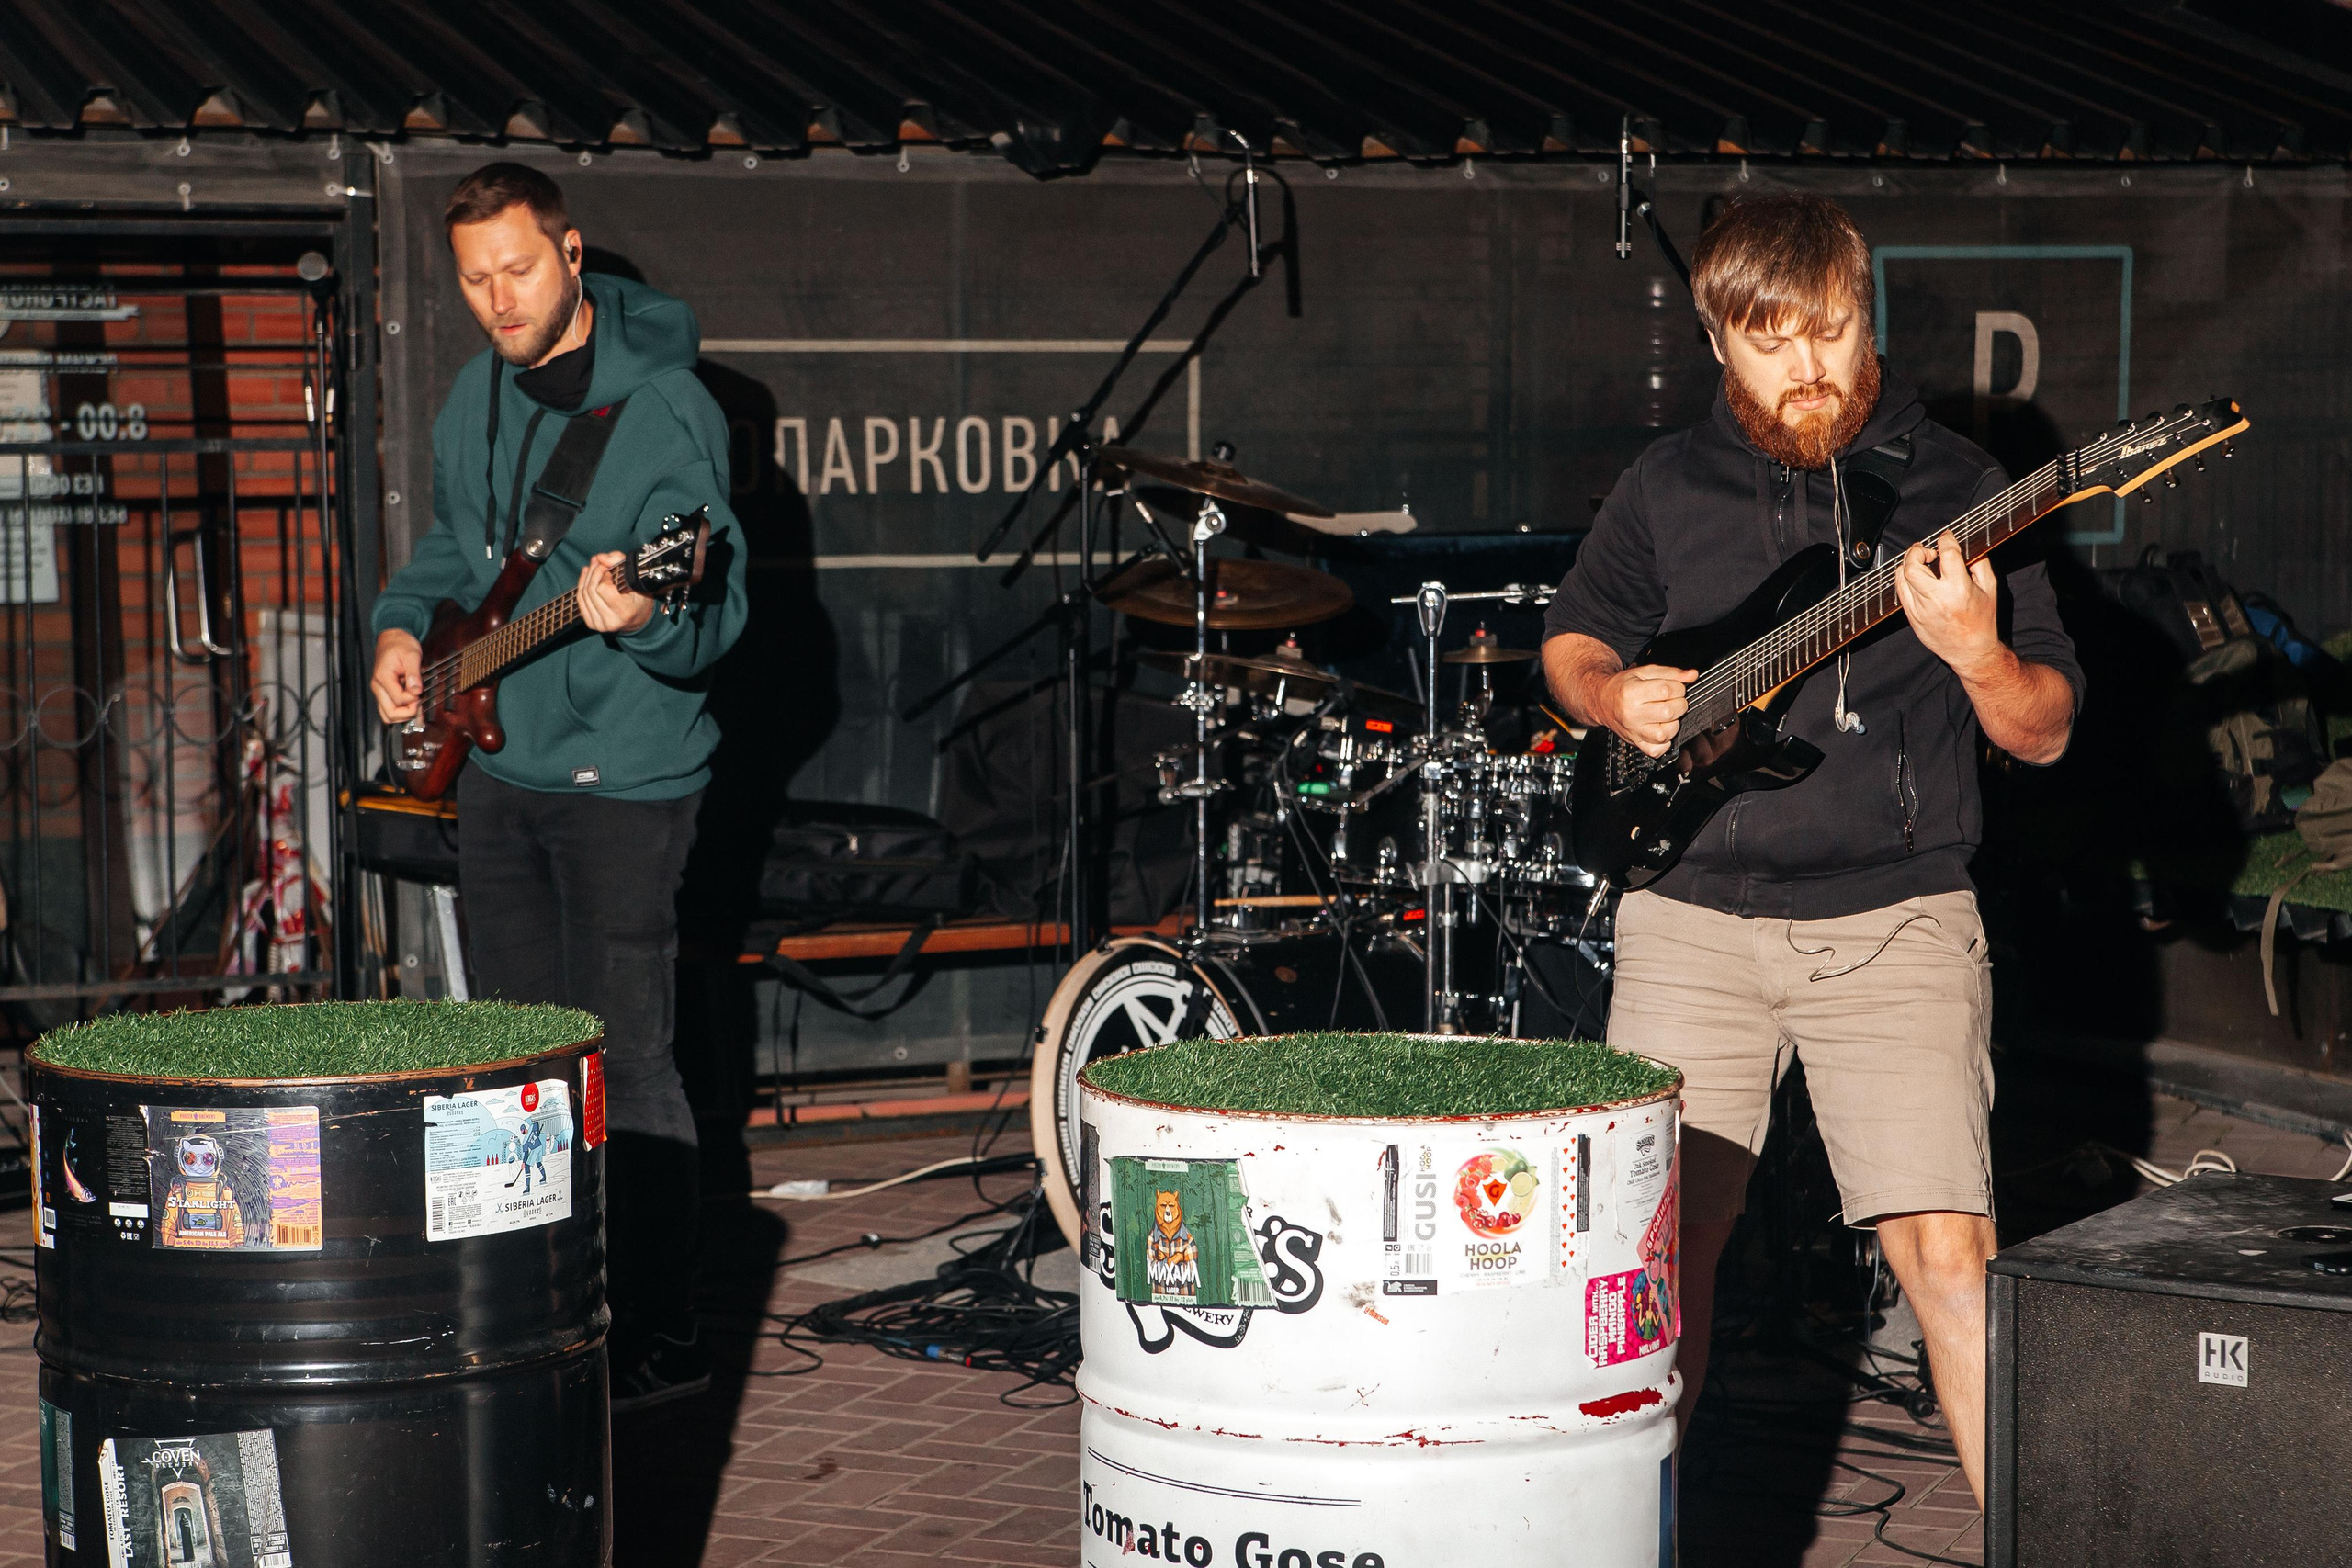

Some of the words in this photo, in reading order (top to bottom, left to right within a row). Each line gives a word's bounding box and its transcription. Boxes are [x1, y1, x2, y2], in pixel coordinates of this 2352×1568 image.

[458, 1100, 478, 1109] LAGER
[168, 1197, 235, 1209] STARLIGHT
[504, 1200, 535, 1212] SIBERIA
[537, 1193, 557, 1206] LAGER
[1488, 1184, 1499, 1198] G
[1415, 1174, 1436, 1240] GUSI
[1465, 1242, 1521, 1256] HOOLA
[1470, 1256, 1517, 1270] HOOP
[1147, 1258, 1201, 1288] МИХАИЛ
[1599, 1280, 1608, 1366] RASPBERRY
[1608, 1292, 1617, 1344] MANGO
[1617, 1276, 1626, 1355] PINEAPPLE
[1589, 1315, 1598, 1359] CIDER
[2205, 1337, 2244, 1371] HK
[2205, 1371, 2244, 1382] AUDIO
[152, 1449, 200, 1463] COVEN
[117, 1465, 130, 1518] RESORT
[107, 1506, 115, 1541] TOMATO
[1083, 1479, 1213, 1568] Tomato
[1235, 1532, 1385, 1568] Gose
[123, 1528, 134, 1558] LAST
